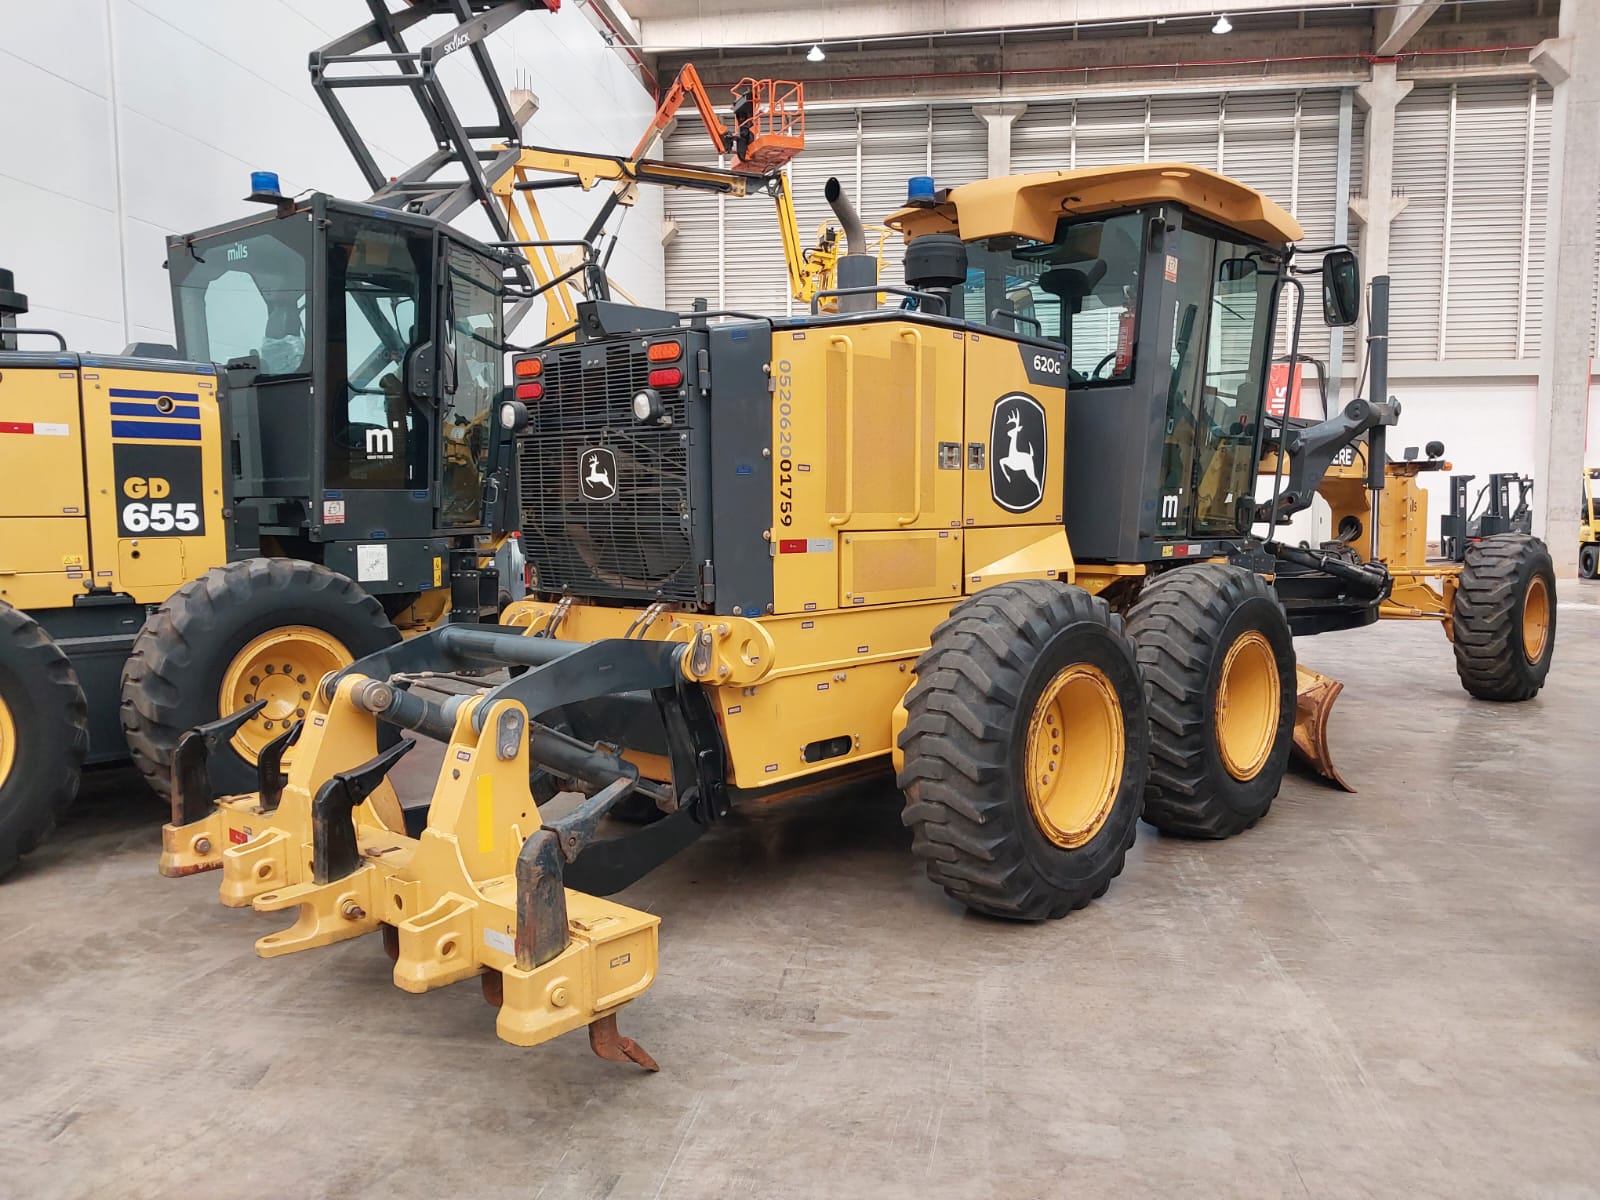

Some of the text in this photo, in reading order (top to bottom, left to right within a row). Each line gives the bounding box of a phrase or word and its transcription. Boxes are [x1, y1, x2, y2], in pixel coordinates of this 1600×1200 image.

[227, 241, 248, 261] mills
[1033, 354, 1061, 375] 620G
[1266, 386, 1287, 416] ills
[123, 476, 171, 499] GD
[122, 502, 200, 532] 655
